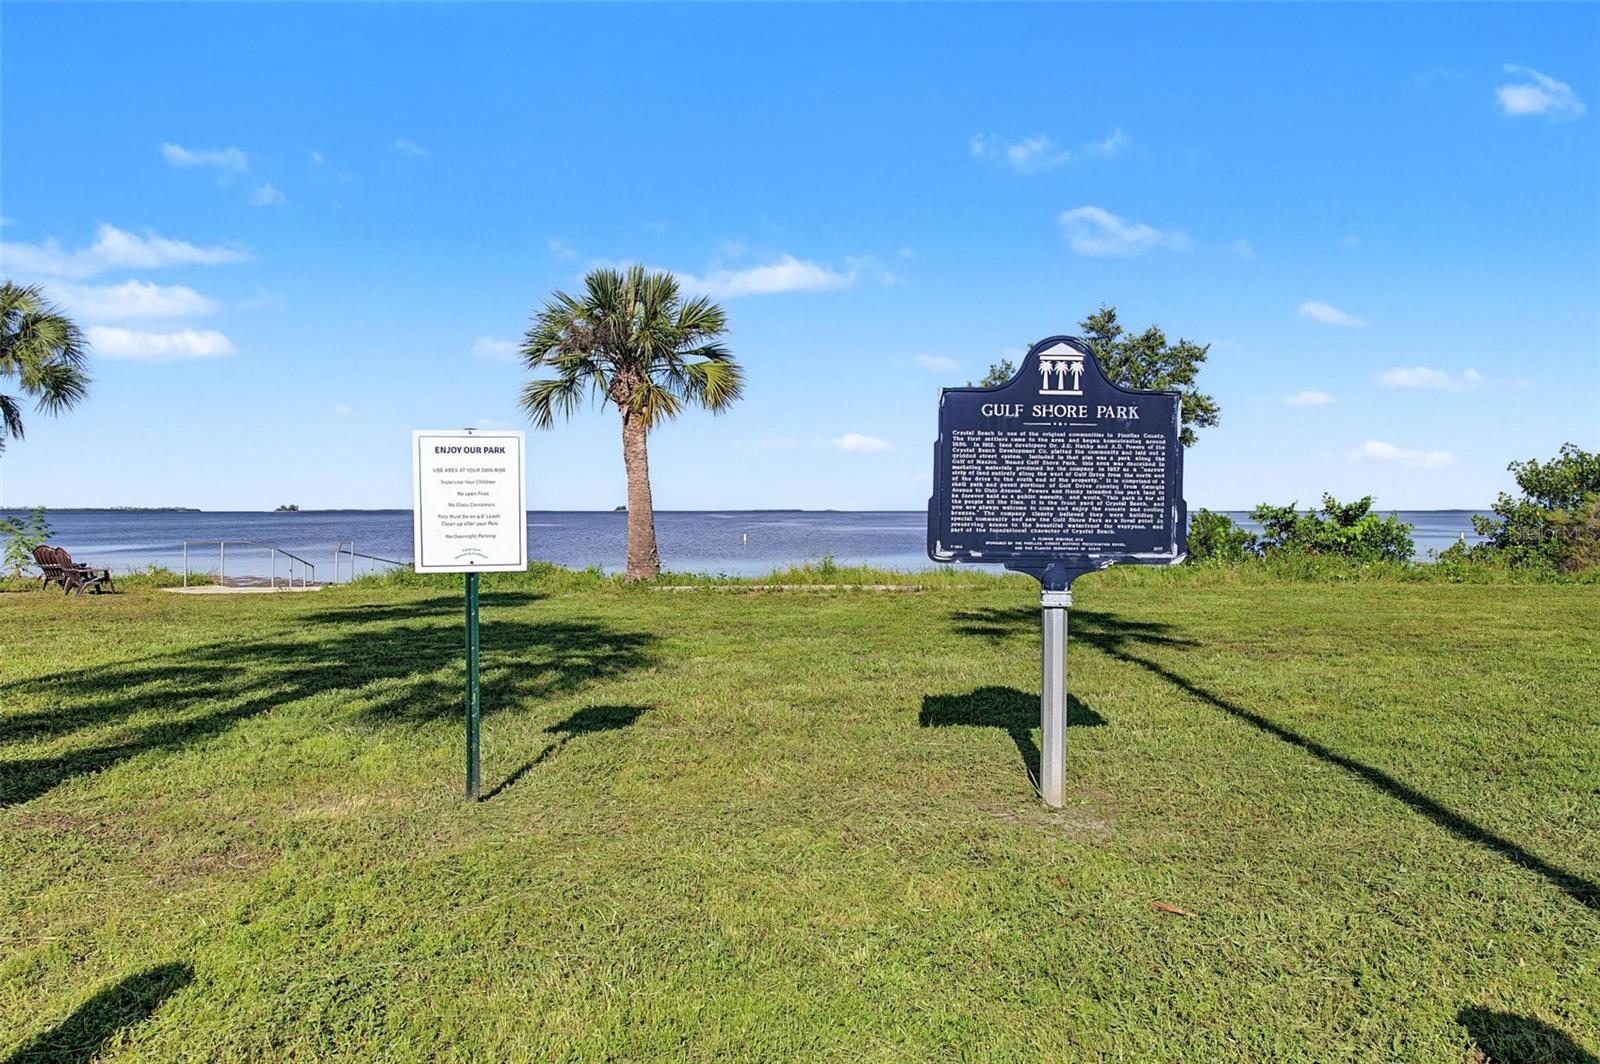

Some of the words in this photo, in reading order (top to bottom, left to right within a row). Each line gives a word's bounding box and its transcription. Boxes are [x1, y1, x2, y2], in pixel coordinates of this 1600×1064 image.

[981, 403, 1024, 417] GULF
[1032, 404, 1088, 418] SHORE
[1096, 405, 1140, 419] PARK
[434, 446, 462, 454] ENJOY
[463, 446, 482, 454] OUR
[483, 446, 506, 454] PARK
